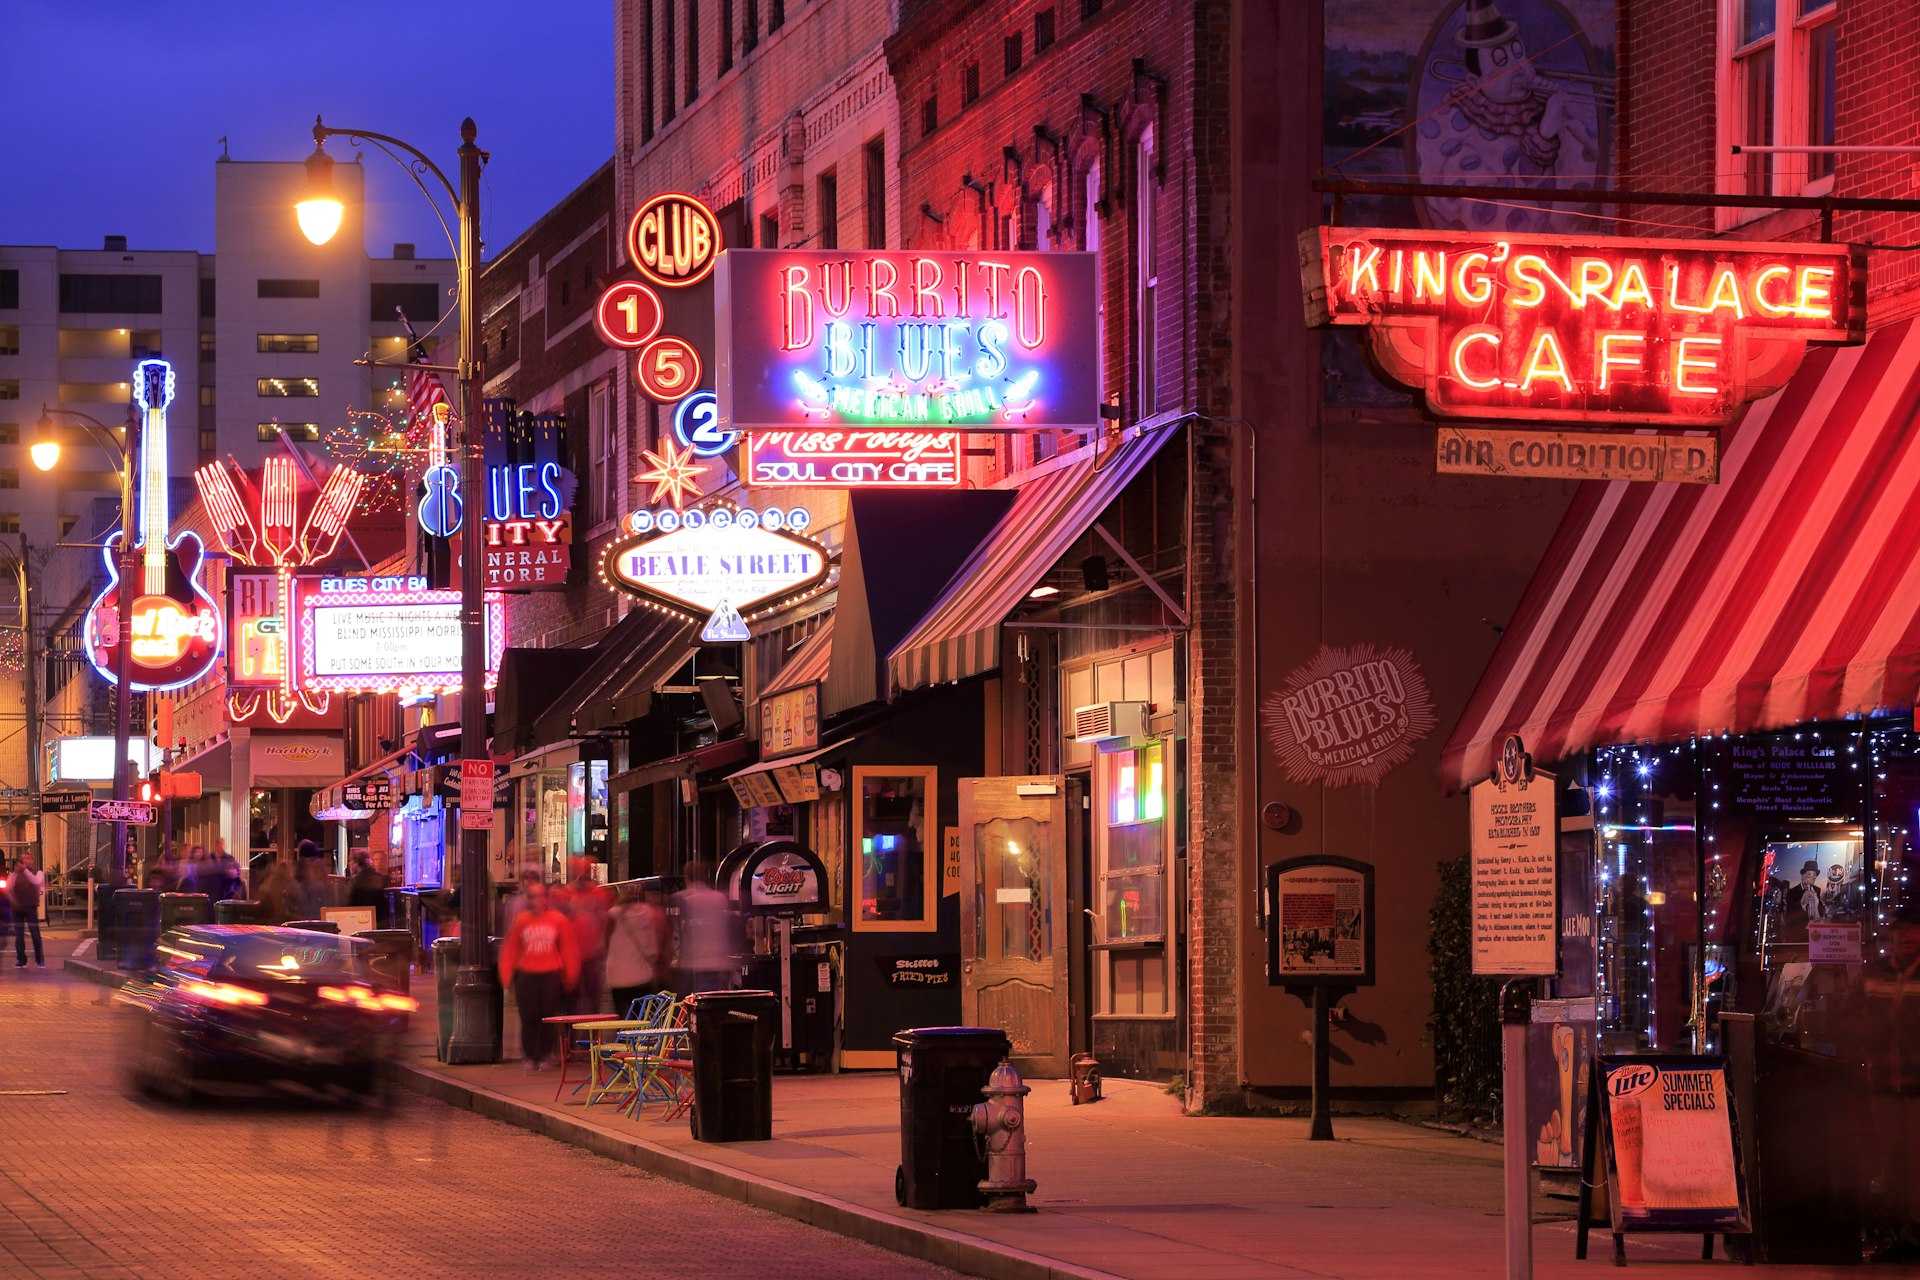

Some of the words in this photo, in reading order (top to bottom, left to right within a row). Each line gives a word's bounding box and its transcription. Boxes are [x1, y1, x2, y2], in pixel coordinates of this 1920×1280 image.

[638, 203, 712, 276] CLUB
[1350, 241, 1547, 309] KING'S
[1571, 256, 1835, 320] PALACE
[779, 257, 1048, 352] BURRITO
[617, 294, 638, 334] 1
[824, 320, 1009, 384] BLUES
[1449, 324, 1724, 396] CAFE
[653, 348, 686, 389] 5
[830, 383, 929, 421] MEXICAN
[941, 386, 1002, 420] GRILL
[692, 402, 719, 443] 2
[1445, 438, 1494, 467] AIR
[755, 462, 827, 482] SOUL
[831, 462, 884, 482] CITY
[888, 462, 955, 482] CAFE
[438, 462, 563, 537] BUES
[633, 510, 809, 529] WELCOME
[476, 521, 564, 546] ITY
[458, 550, 563, 568] NERAL
[630, 555, 711, 577] BEALE
[719, 553, 813, 574] STREET
[320, 578, 369, 593] BLUES
[371, 576, 404, 592] CITY
[484, 567, 545, 584] TORE
[333, 613, 352, 625] LIVE
[356, 612, 385, 624] MUSIC
[397, 610, 431, 623] NIGHTS
[337, 628, 366, 640] BLIND
[370, 626, 423, 638] MISSISSIPPI
[330, 658, 347, 670] PUT
[349, 657, 373, 670] SOME
[375, 657, 404, 669] SOUTH
[406, 657, 416, 668] IN
[419, 656, 443, 669] YOUR
[1281, 659, 1406, 744] BURRITO
[1309, 693, 1396, 749] BLUES
[265, 747, 299, 755] Hard
[299, 746, 332, 755] Rock
[1324, 740, 1370, 765] MEXICAN
[1371, 727, 1401, 751] GRILL
[1732, 746, 1766, 759] King's
[1771, 746, 1806, 757] Palace
[1811, 746, 1836, 757] Cafe
[468, 763, 488, 775] NO
[464, 779, 490, 787] PARKING
[464, 788, 491, 796] STANDING
[42, 795, 65, 803] Bernard
[65, 795, 71, 803] J.
[71, 795, 90, 804] Lansky
[1509, 802, 1537, 814] BROTHERS
[108, 807, 124, 815] ONE
[1495, 815, 1533, 827] PHOTOGRAPHY
[763, 867, 805, 885] Coors
[765, 882, 807, 895] LIGHT
[896, 959, 940, 969] Skillet
[892, 971, 925, 984] FRIED
[925, 972, 949, 985] PIES
[1619, 1065, 1644, 1076] Miller
[1614, 1071, 1651, 1097] Lite
[1662, 1073, 1714, 1092] SUMMER
[1663, 1093, 1716, 1111] SPECIALS
